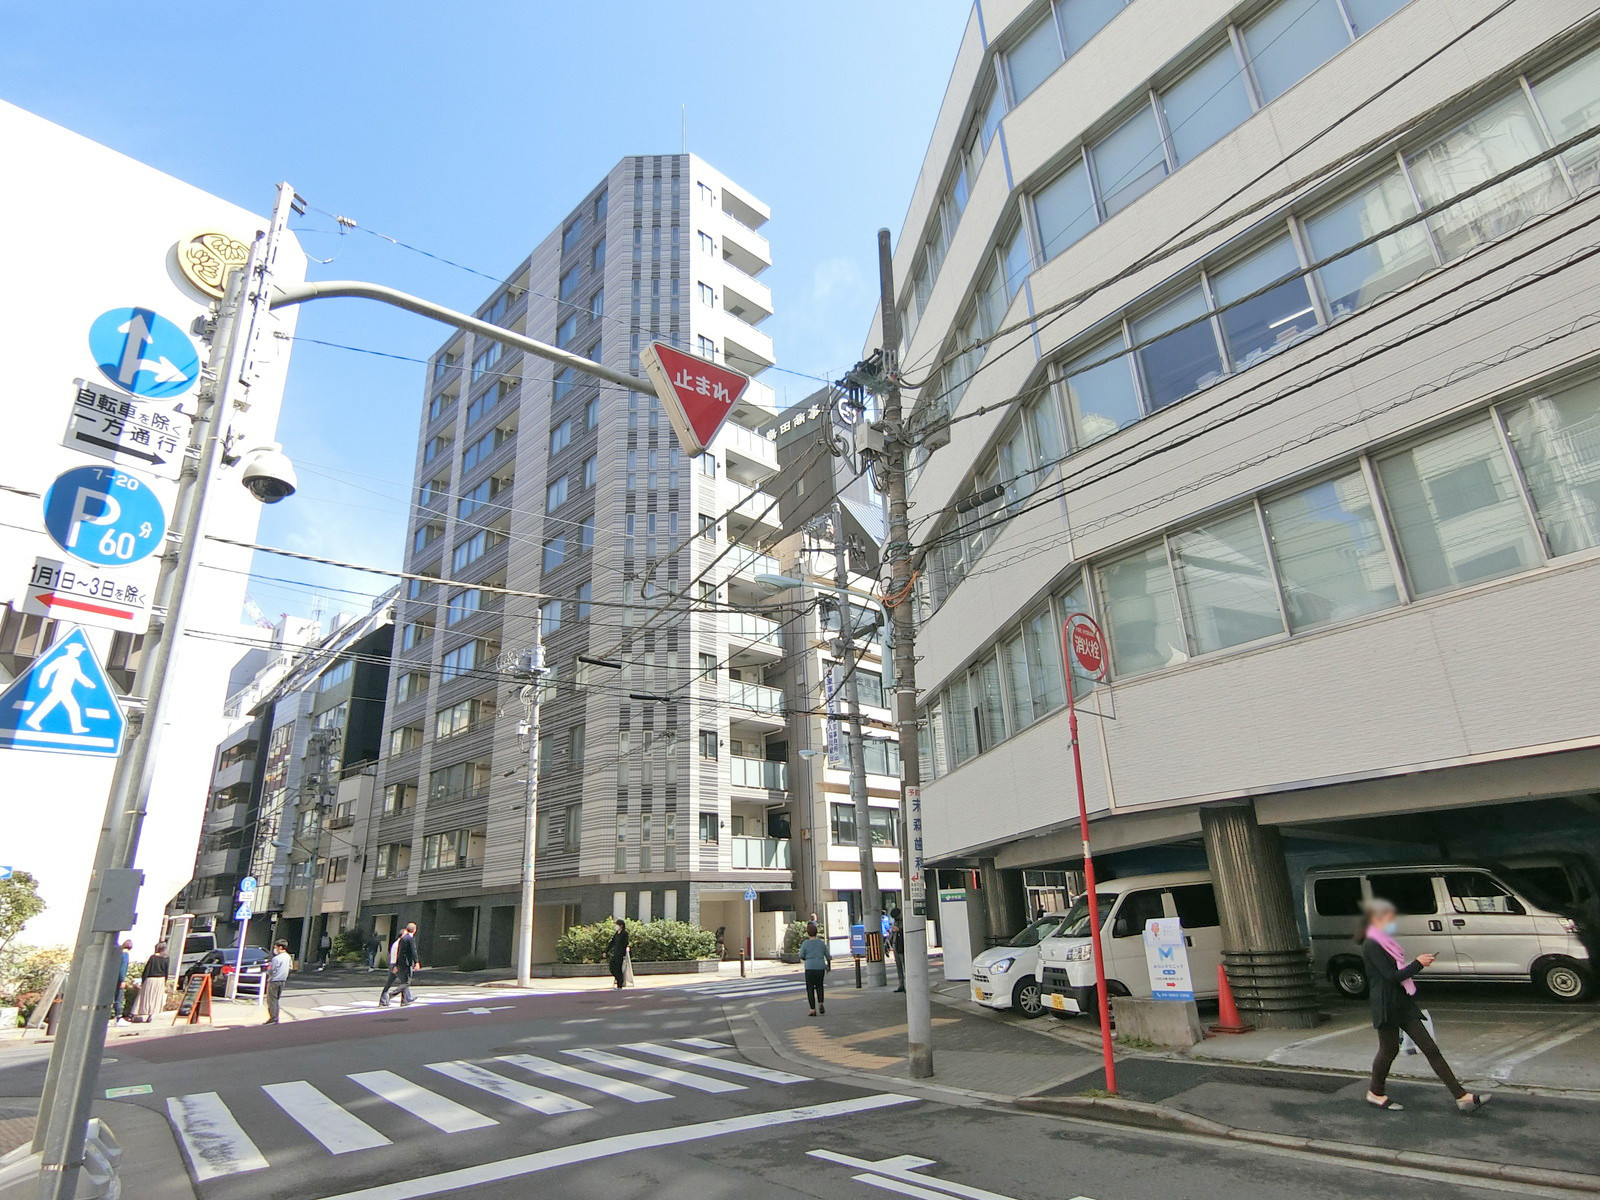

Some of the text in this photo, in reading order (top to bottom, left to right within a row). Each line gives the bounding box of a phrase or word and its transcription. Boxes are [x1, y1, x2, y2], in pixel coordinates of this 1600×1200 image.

[673, 368, 731, 404] 止まれ
[74, 412, 178, 455] 一方通行
[75, 388, 182, 437] 自転車を除く
[65, 486, 122, 548] P
[1074, 635, 1101, 660] 消火栓
